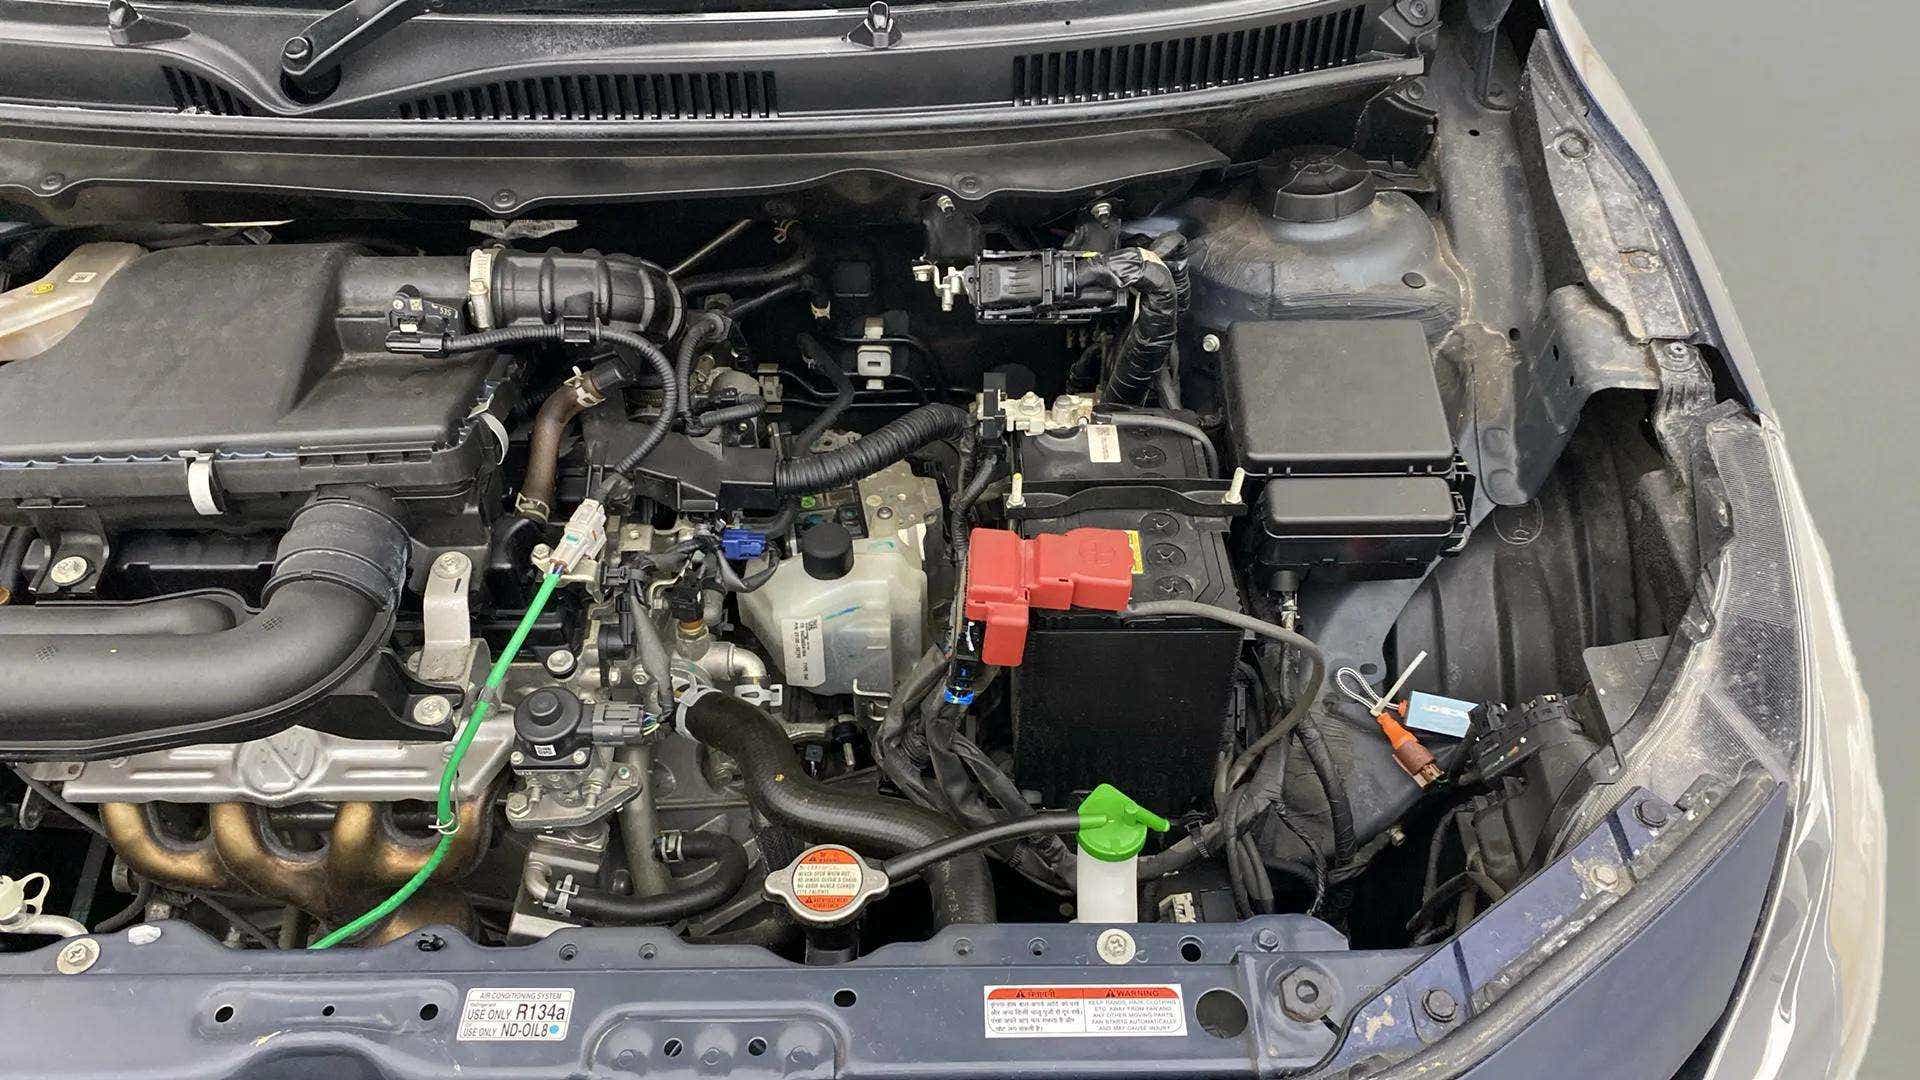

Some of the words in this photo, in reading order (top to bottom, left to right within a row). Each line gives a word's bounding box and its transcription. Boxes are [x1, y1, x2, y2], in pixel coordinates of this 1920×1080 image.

[468, 1009, 484, 1020] USE
[488, 1009, 512, 1020] ONLY
[516, 1003, 566, 1020] R134a
[463, 1028, 478, 1037] USE
[478, 1028, 498, 1037] ONLY
[500, 1022, 548, 1038] ND-OIL8
